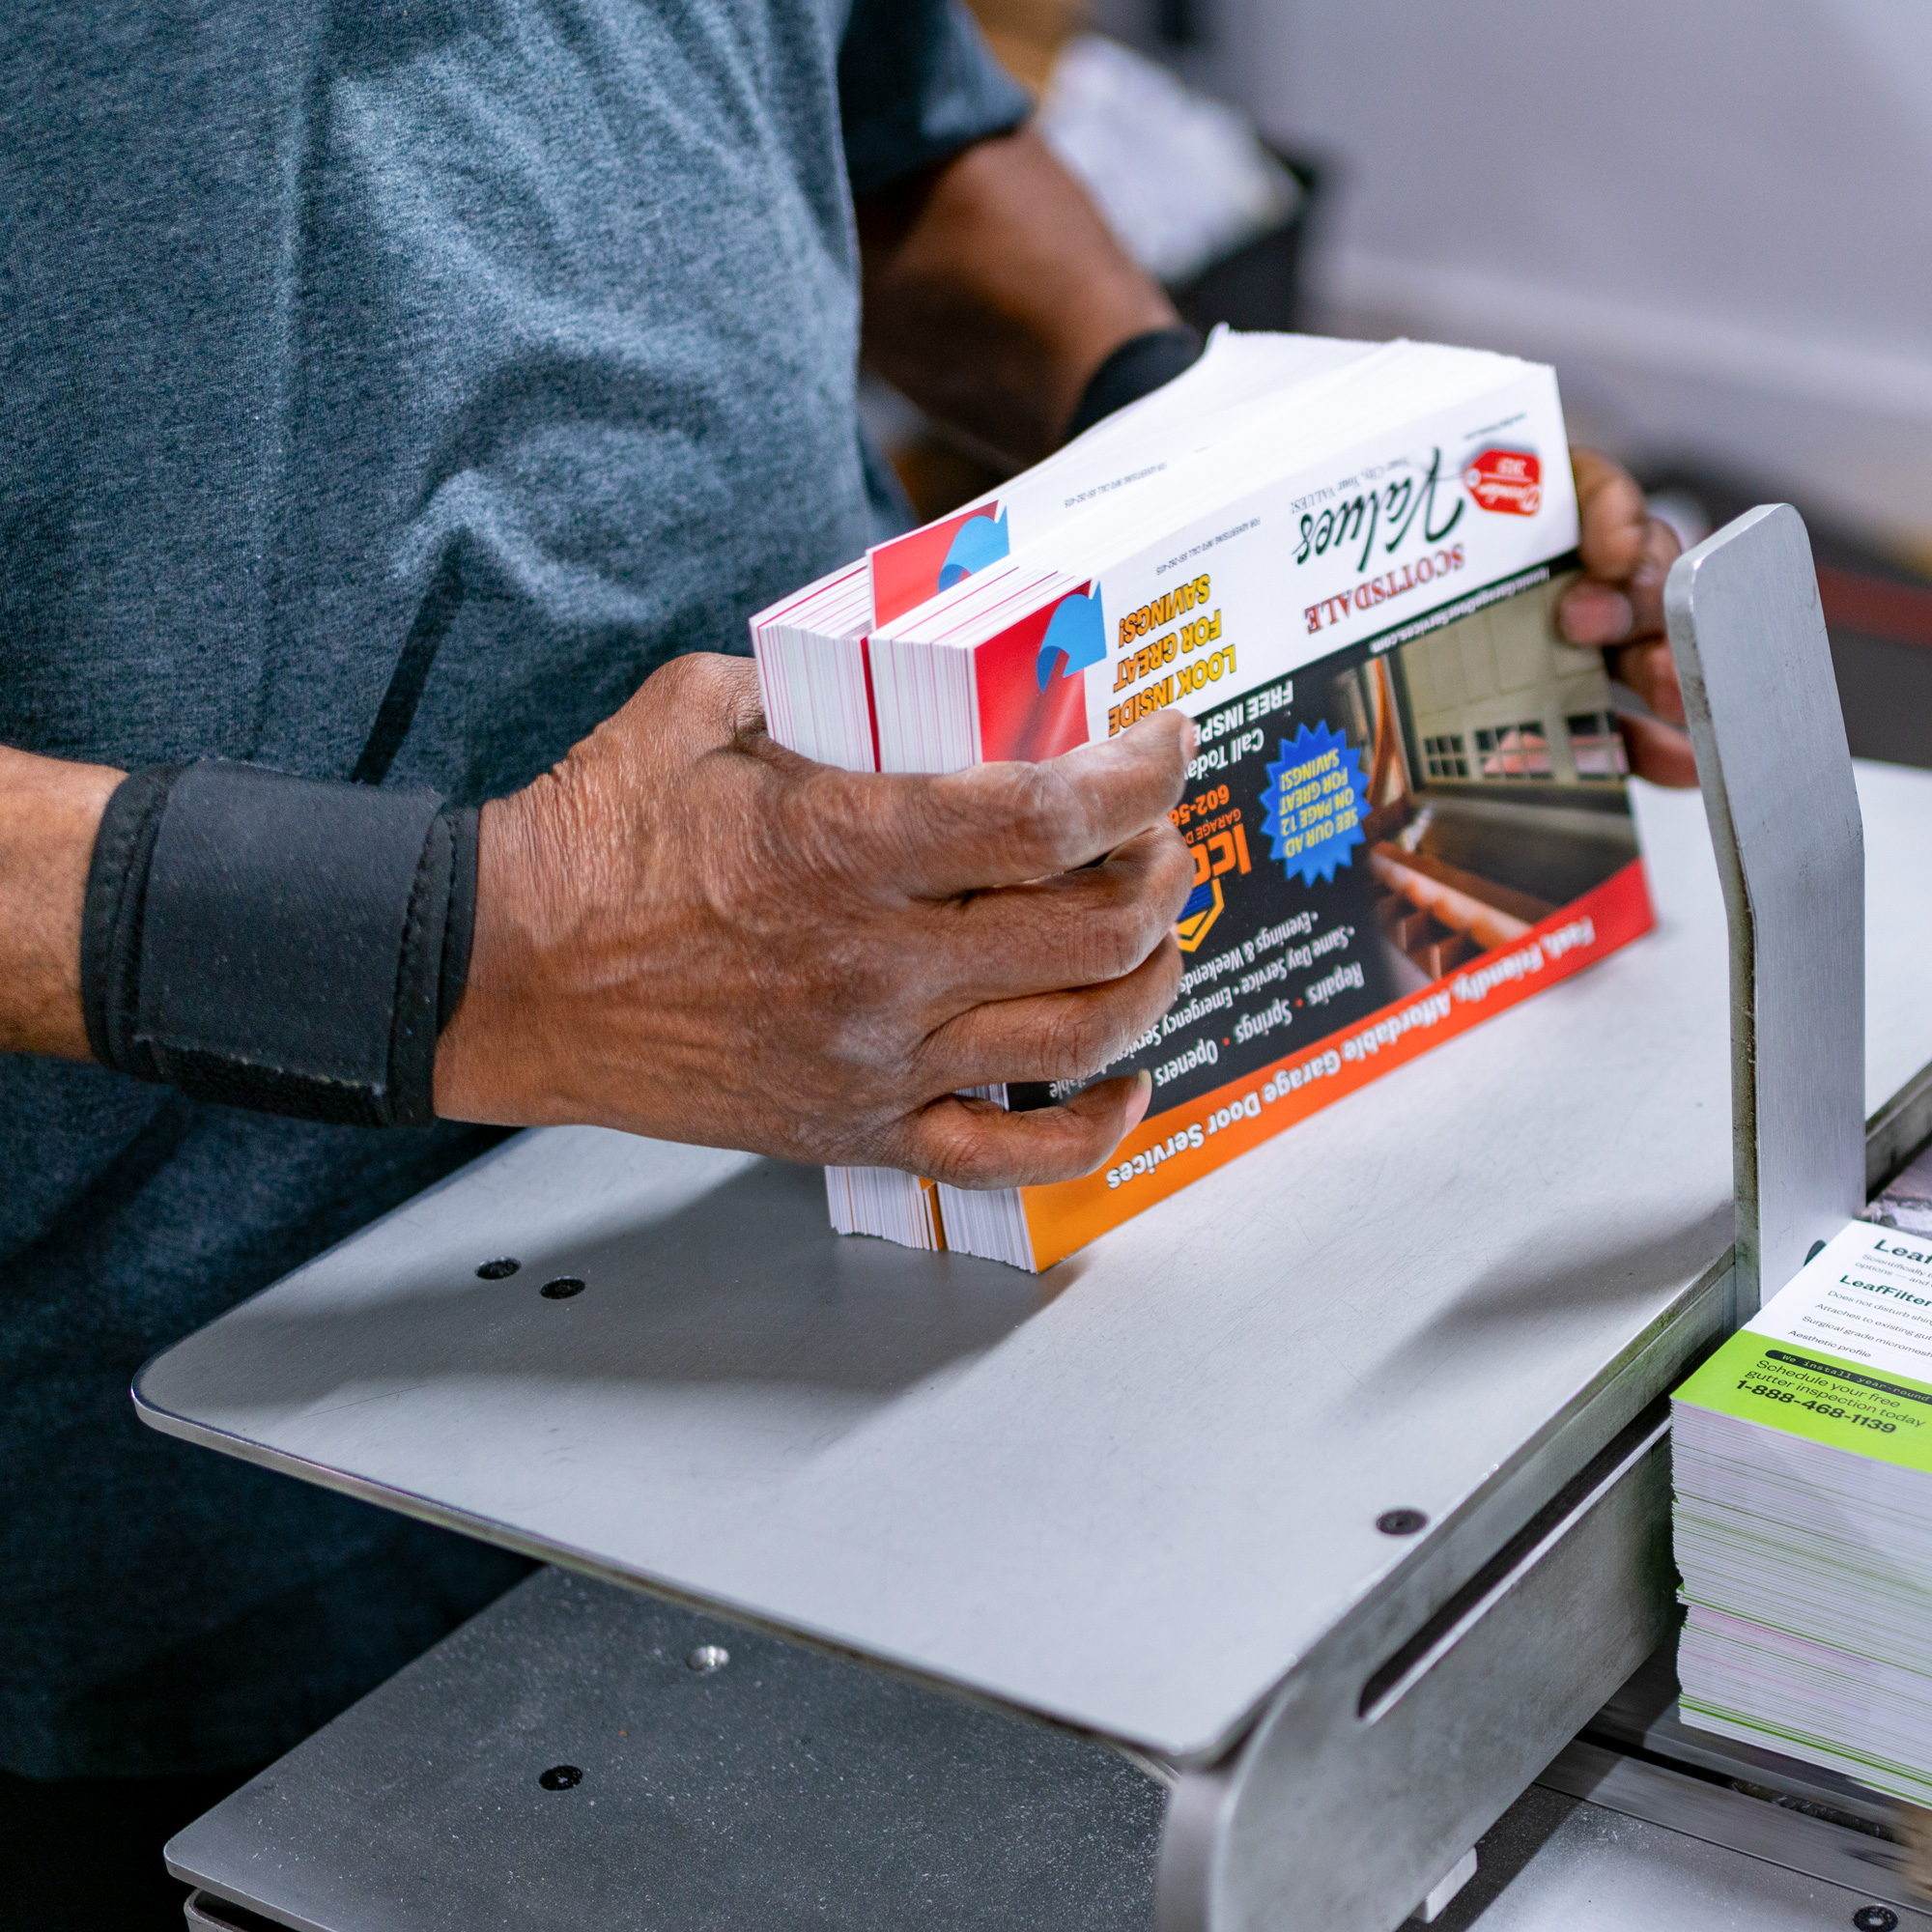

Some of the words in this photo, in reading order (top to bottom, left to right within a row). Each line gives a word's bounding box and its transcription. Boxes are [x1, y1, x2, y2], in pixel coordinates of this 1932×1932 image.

[1291, 486, 1336, 514] VALUES!
[1292, 446, 1465, 573] Values
[1303, 542, 1464, 635] SCOTTSDALE
[1118, 573, 1211, 649] SAVINGS!
[1179, 608, 1222, 654] FOR
[1113, 632, 1179, 694] GREAT
[1176, 643, 1236, 700] LOOK
[1108, 674, 1174, 738] INSIDE
[1246, 679, 1294, 722] FREE
[1192, 702, 1244, 747] INSPE
[1230, 727, 1264, 764] Call
[1183, 745, 1229, 781] Toda
[1280, 747, 1340, 792] SAVINGS!
[1322, 766, 1349, 795] FOR
[1168, 783, 1230, 827] 602-56
[1279, 781, 1321, 816] GREAT
[1299, 797, 1333, 829] PAGE
[1334, 786, 1354, 811] ON
[1195, 808, 1241, 840] GARAGE
[1280, 814, 1297, 837] 12
[1305, 819, 1334, 848] OUR
[1336, 807, 1359, 835] SEE
[1284, 833, 1304, 858] AD
[1241, 940, 1256, 963] &
[1254, 910, 1313, 953] Evenings
[1312, 924, 1350, 958] Same
[1179, 947, 1245, 995] Weekends
[1238, 956, 1288, 993] Service
[1286, 944, 1314, 972] Day
[1305, 960, 1366, 1007] Repairs
[1161, 985, 1235, 1037] Emergency
[1233, 997, 1293, 1044] Springs
[1341, 988, 1452, 1062] Affordable
[1152, 1037, 1219, 1088] Openers
[1262, 1048, 1342, 1103] Garage
[1208, 1091, 1263, 1136] Door
[1105, 1121, 1206, 1189] Services
[1855, 1262, 1893, 1276] options
[1909, 1277, 1930, 1286] and
[1861, 1254, 1926, 1276] Scientifically
[1828, 1290, 1854, 1303] Does
[1855, 1298, 1873, 1308] not
[1873, 1301, 1910, 1318] disturb
[1839, 1274, 1932, 1307] LeafFilter
[1802, 1315, 1845, 1333] Surgical
[1843, 1328, 1875, 1341] grade
[1815, 1303, 1861, 1321] Attaches
[1862, 1316, 1874, 1324] to
[1875, 1321, 1915, 1337] existing
[1787, 1329, 1837, 1349] Aesthetic
[1836, 1344, 1872, 1358] profile
[1745, 1369, 1795, 1389] gutter
[1795, 1382, 1877, 1414] inspection
[1879, 1406, 1926, 1428] today
[1756, 1359, 1829, 1387] Schedule
[1831, 1381, 1868, 1398] your
[1868, 1392, 1901, 1408] free
[1781, 1353, 1798, 1364] We
[1804, 1359, 1852, 1379] install
[1854, 1375, 1932, 1402] year-round
[1736, 1379, 1897, 1434] 1-888-468-1139
